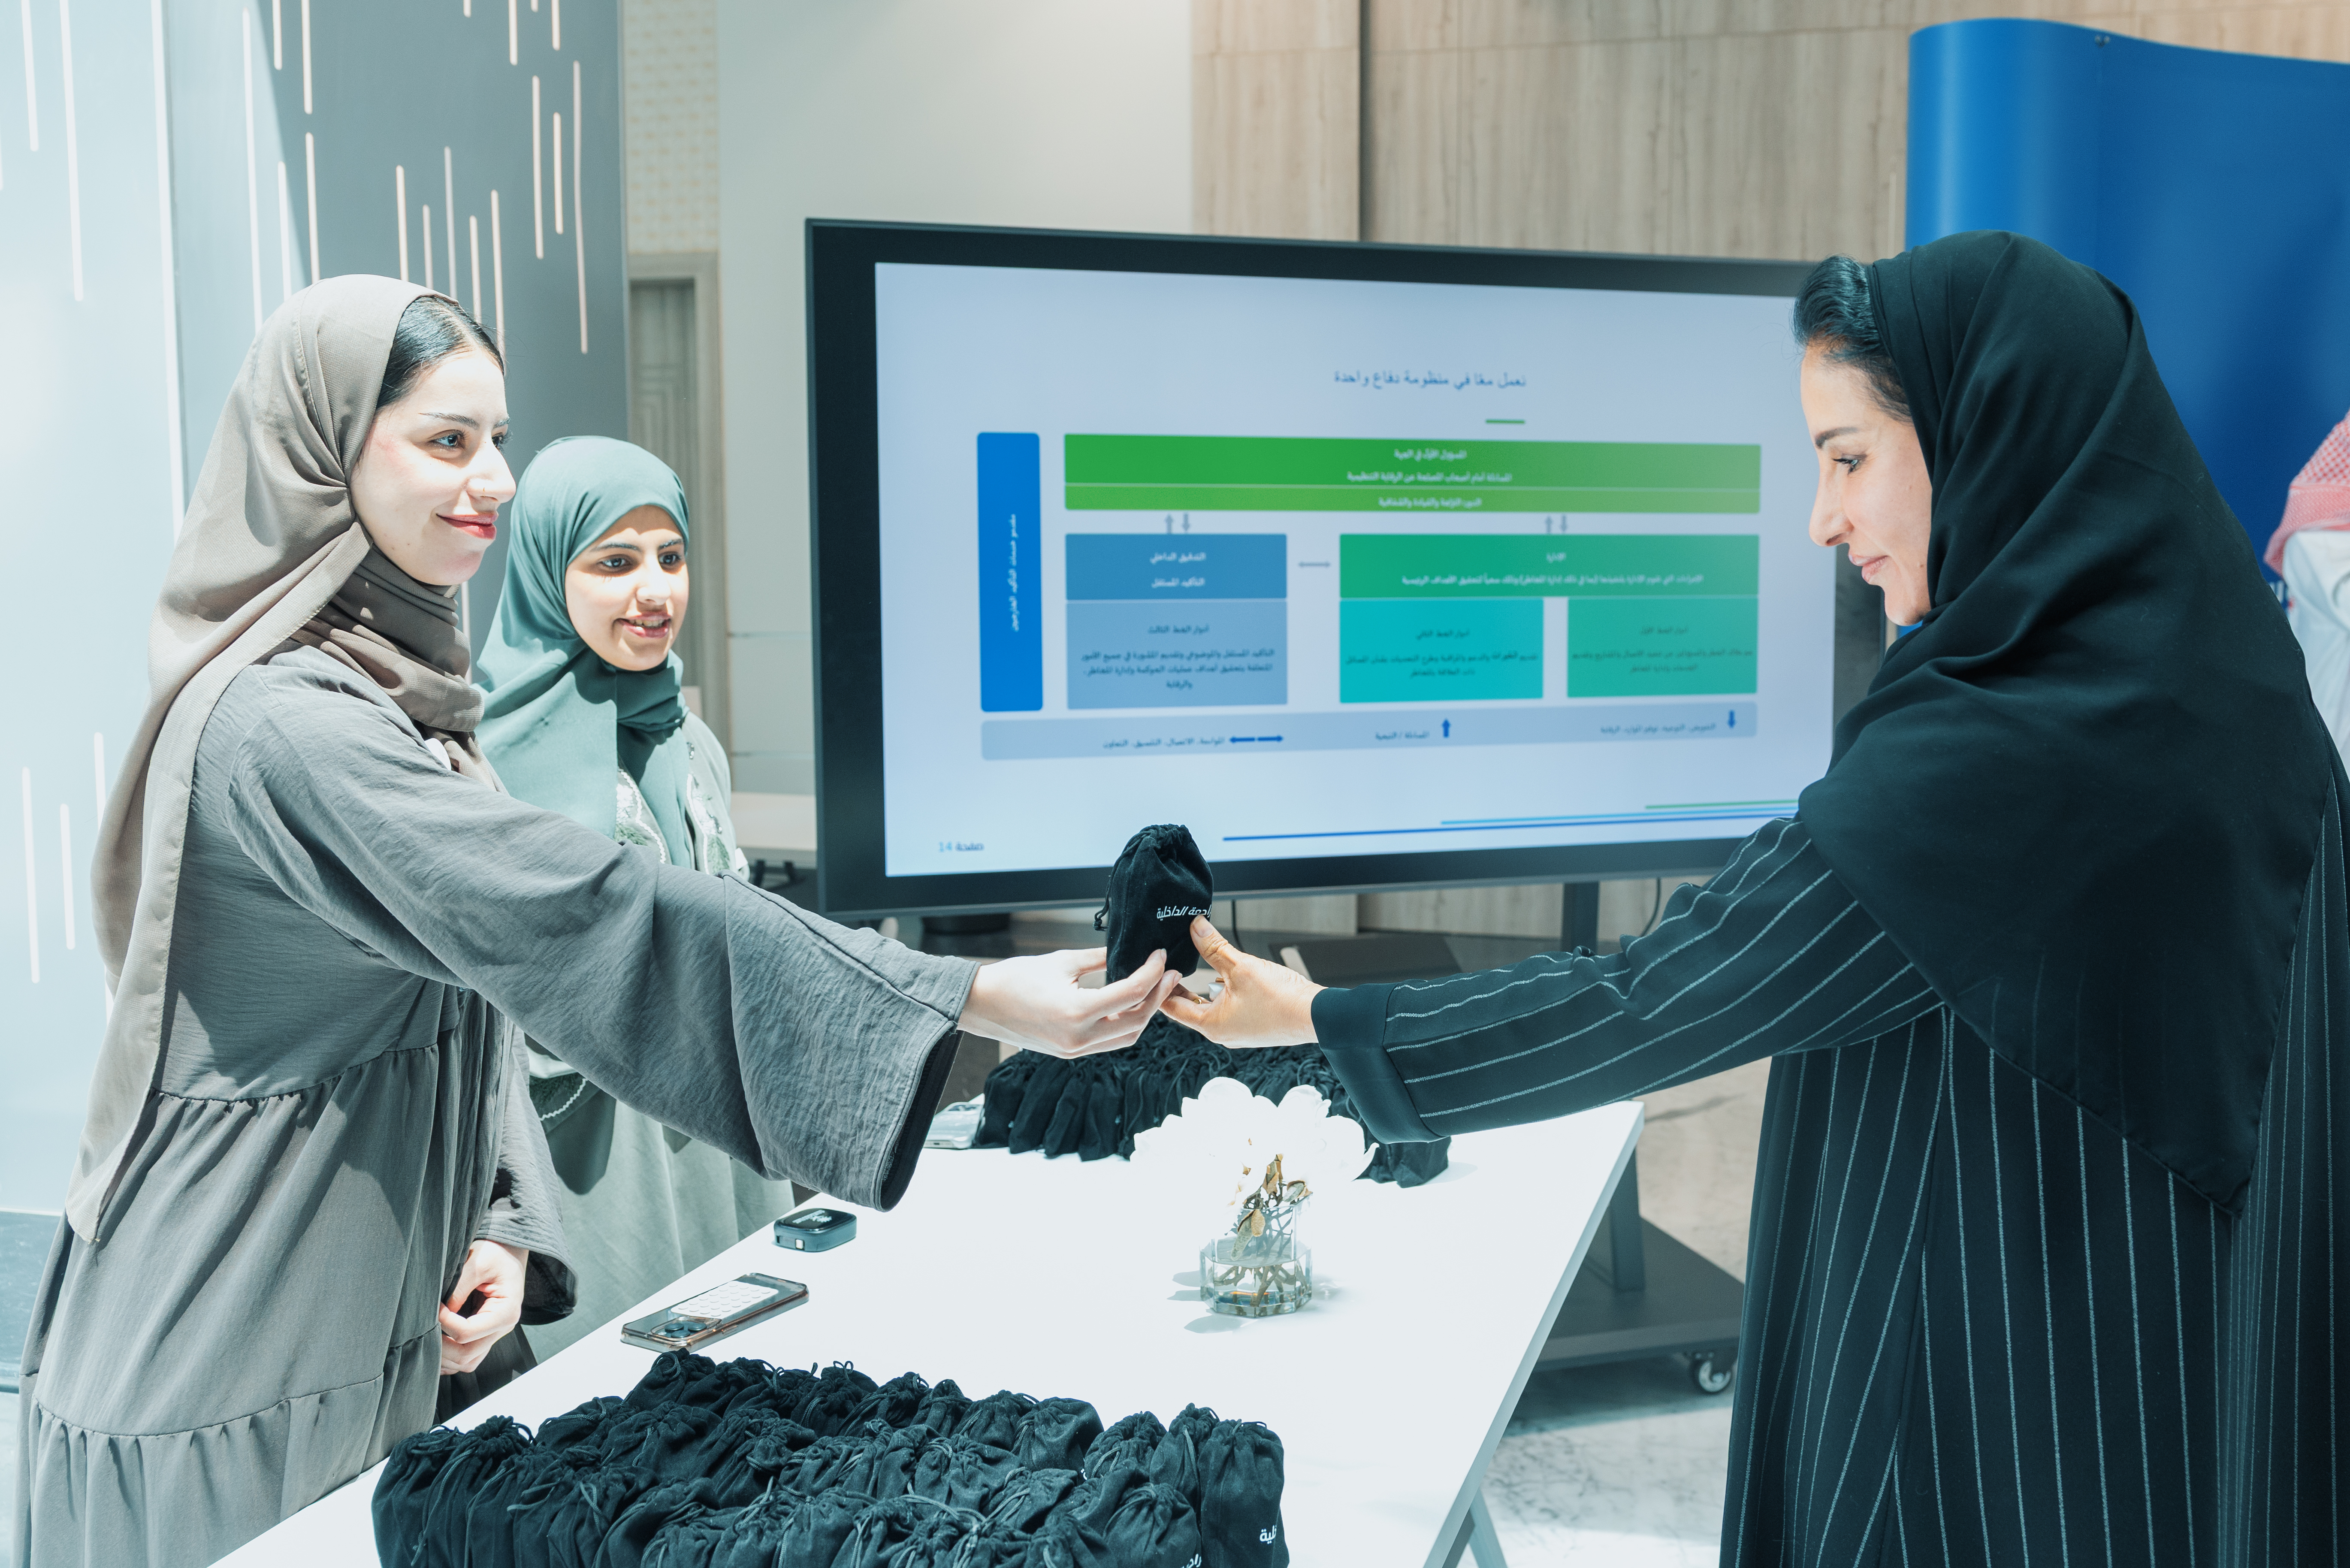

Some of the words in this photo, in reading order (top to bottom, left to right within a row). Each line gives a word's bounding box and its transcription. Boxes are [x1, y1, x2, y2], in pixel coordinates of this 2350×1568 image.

[1335, 371, 1369, 387] واحدة
[1373, 372, 1400, 390] دفاع
[1404, 371, 1449, 388] منظومة
[1454, 375, 1471, 390] في
[1498, 373, 1526, 389] نعمل
[1150, 552, 1177, 564] الداخلي
[1178, 552, 1206, 563] التدقيق
[1151, 578, 1179, 588] المستقل
[1181, 577, 1205, 587] التأكيد
[940, 843, 952, 852] 14
[955, 843, 984, 852] صفحة
[1157, 906, 1189, 921] الداخلية
